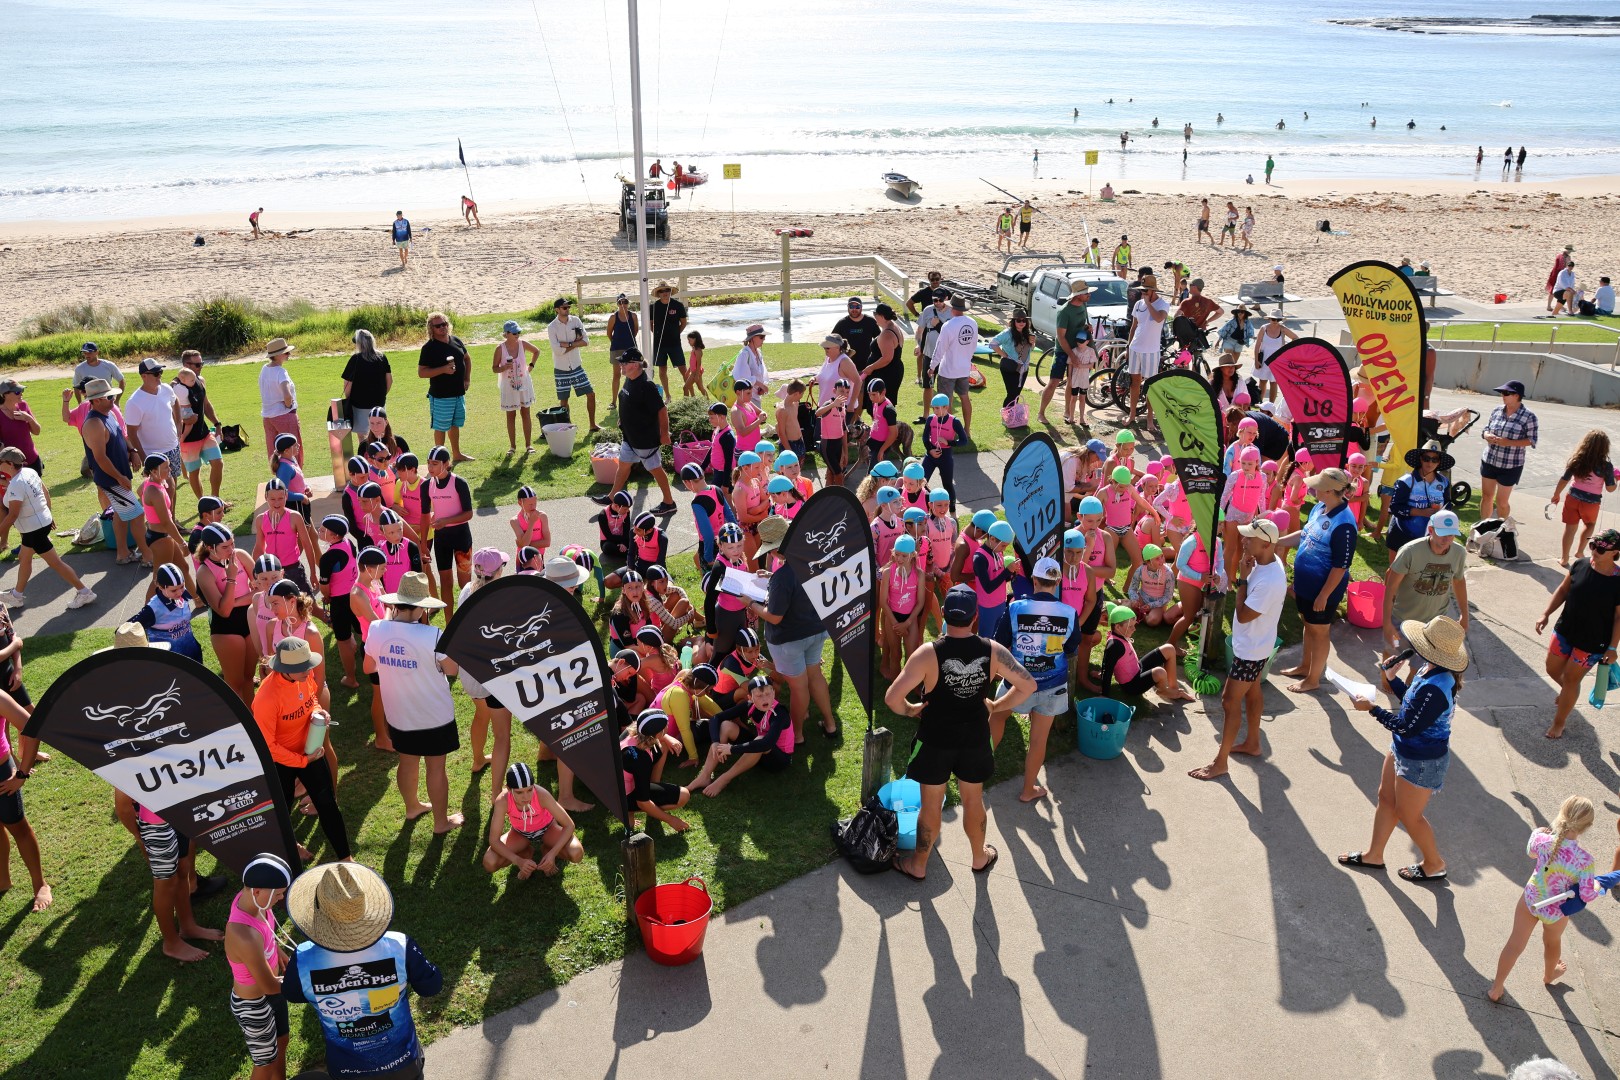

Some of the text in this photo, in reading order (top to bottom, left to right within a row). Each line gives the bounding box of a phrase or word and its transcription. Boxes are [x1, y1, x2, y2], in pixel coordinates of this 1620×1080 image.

[1343, 292, 1413, 311] MOLLYMOOK
[1342, 306, 1413, 323] SURF CLUB SHOP
[1356, 333, 1415, 414] OPEN
[1303, 397, 1333, 418] U8
[1023, 498, 1056, 545] U10
[820, 561, 864, 608] U11
[1018, 623, 1067, 633] Hayden's Pies
[389, 644, 406, 656] AGE
[379, 655, 418, 669] MANAGER
[515, 656, 594, 708] U12
[136, 744, 245, 793] U13/14
[209, 828, 227, 841] YOUR
[227, 821, 248, 834] LOCAL
[314, 973, 397, 993] Hayden's Pies
[320, 1006, 362, 1016] evolve
[354, 1022, 378, 1033] POINT
[367, 1023, 392, 1036] LOANS
